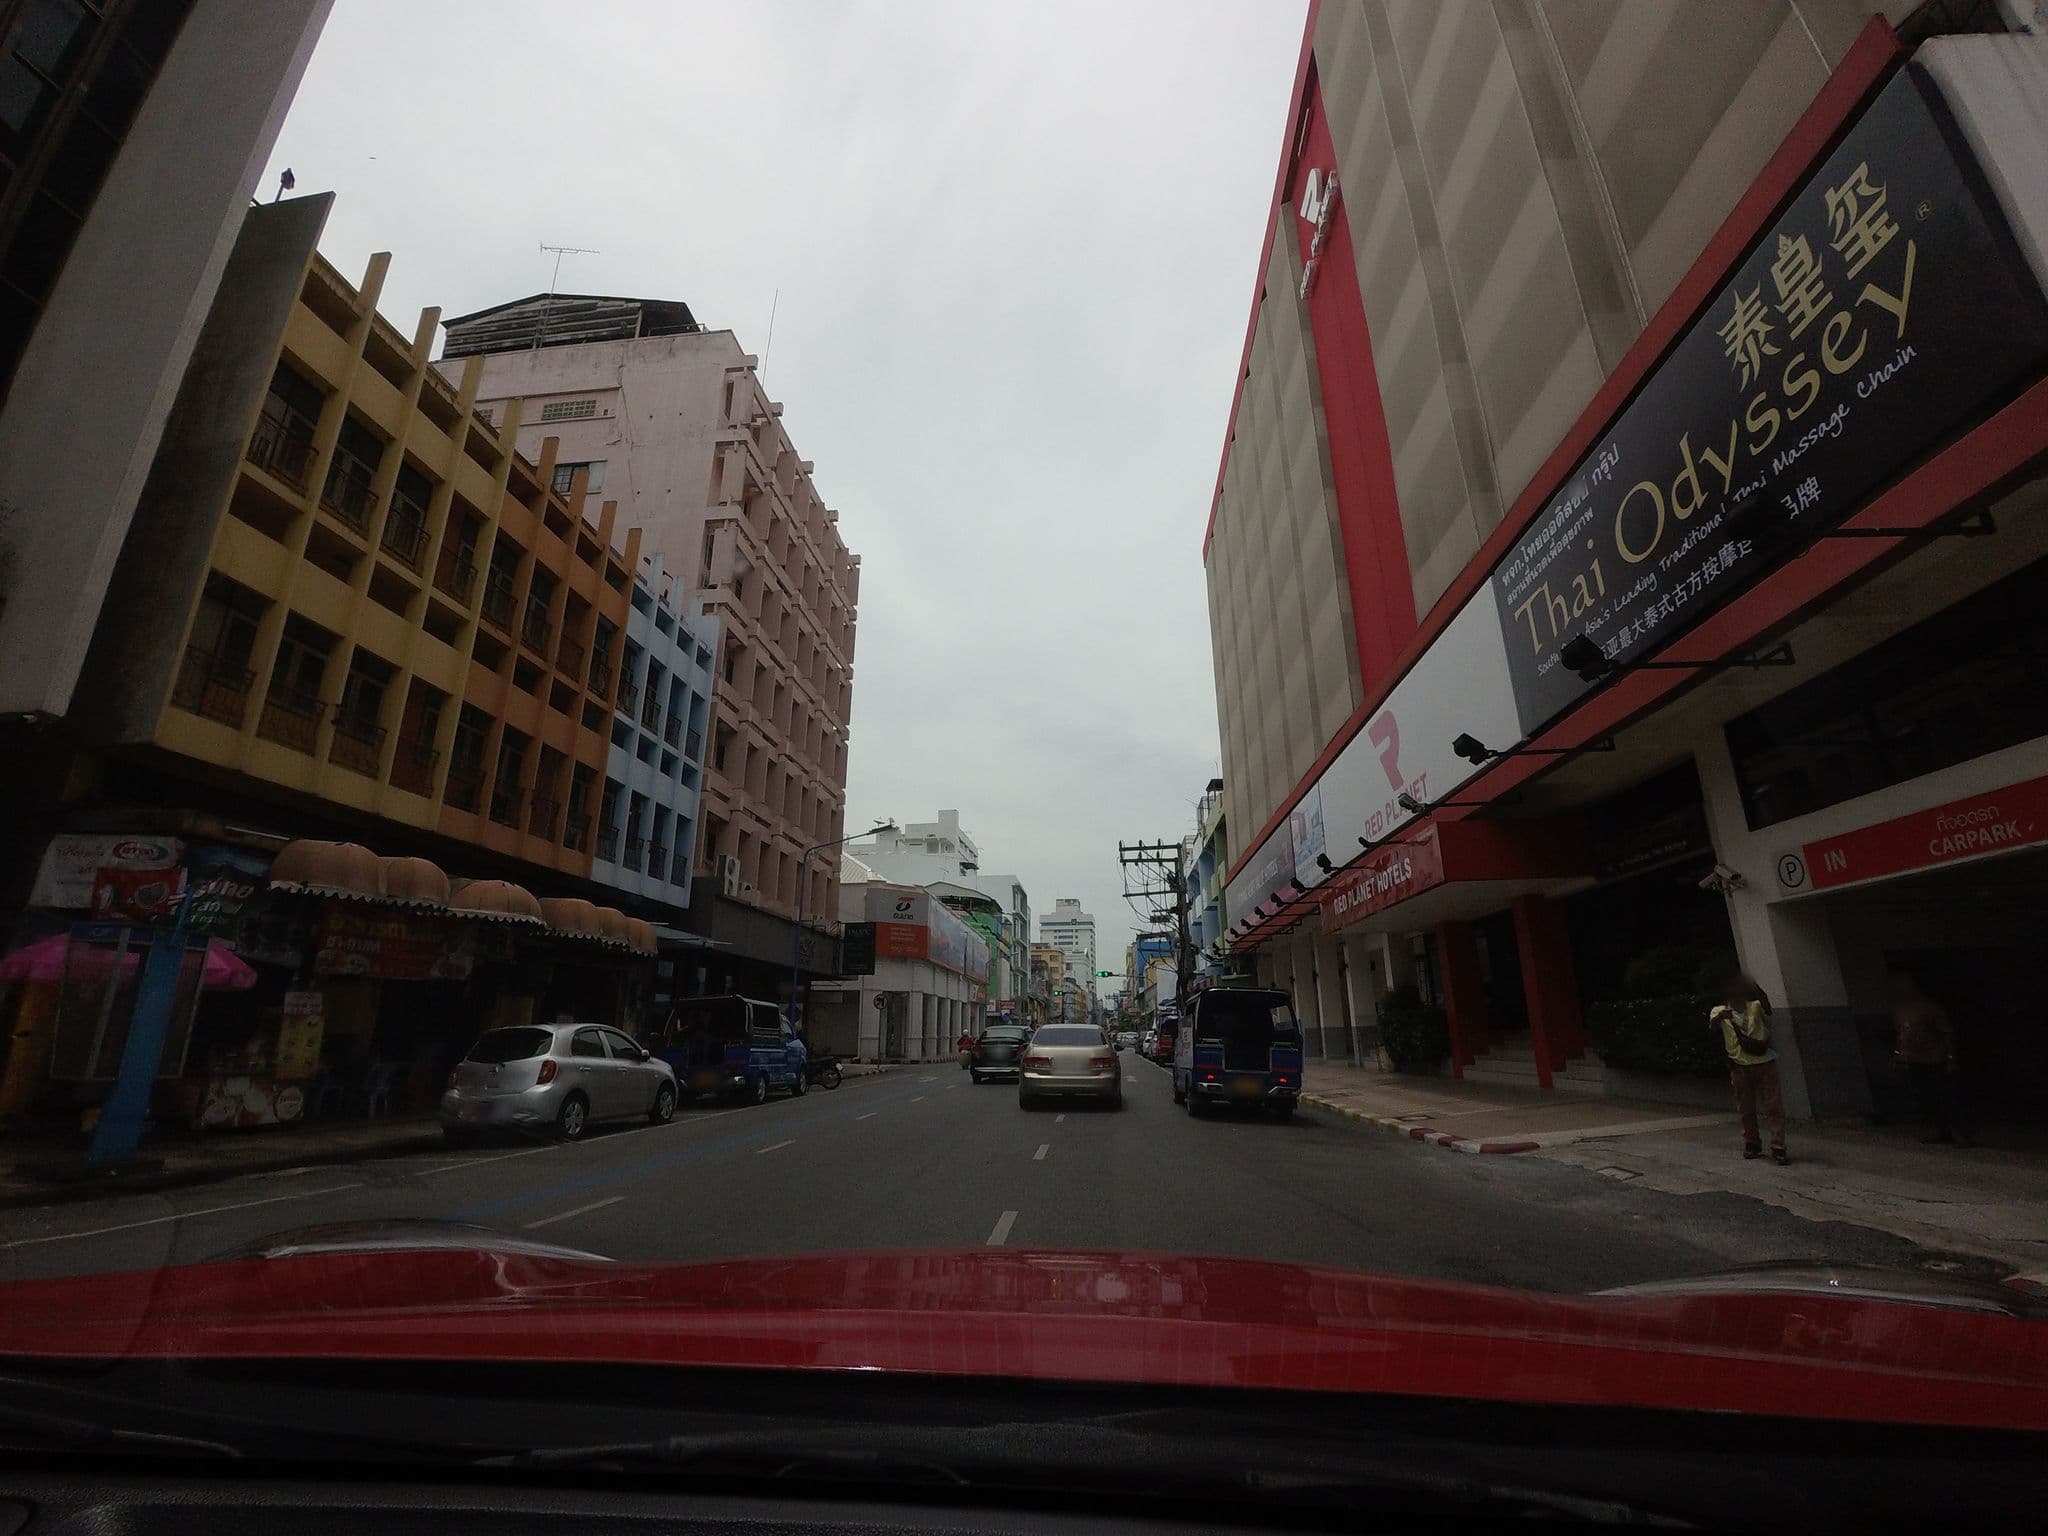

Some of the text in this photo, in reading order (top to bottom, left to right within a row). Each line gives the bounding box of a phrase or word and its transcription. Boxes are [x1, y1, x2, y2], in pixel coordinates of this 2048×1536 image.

[1514, 239, 1917, 656] Thai Odyssey
[1772, 403, 1850, 476] Massage
[1364, 810, 1384, 840] RED
[1823, 849, 1847, 873] IN
[1928, 820, 2022, 856] CARPARK
[1333, 857, 1412, 915] RED PLANET HOTELS
